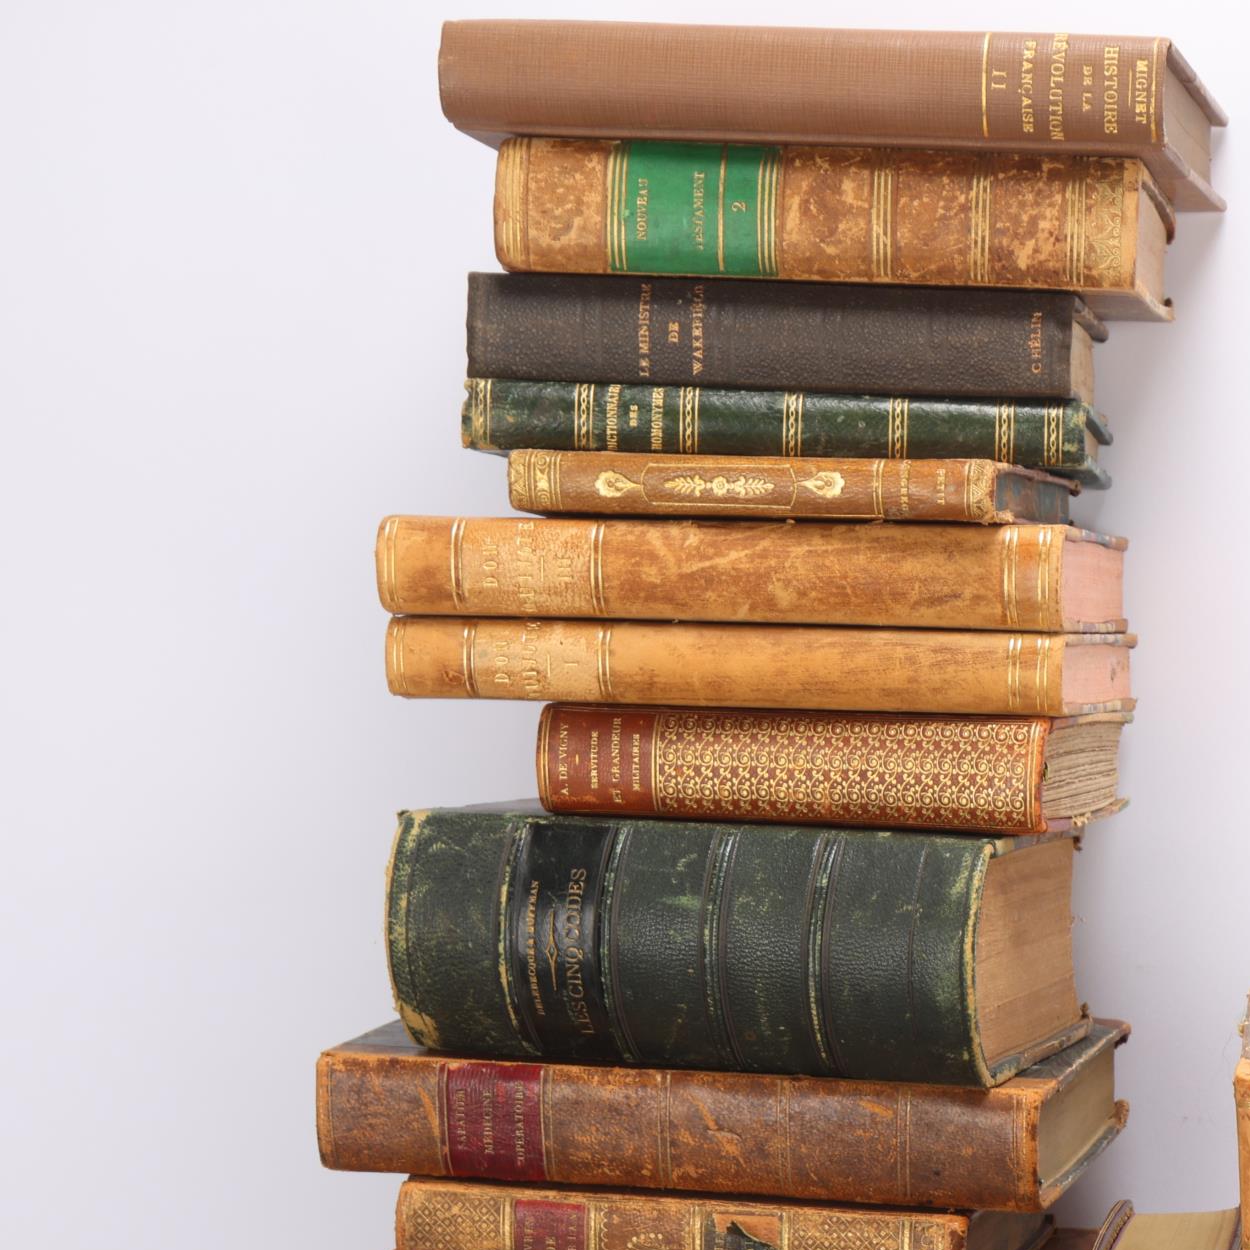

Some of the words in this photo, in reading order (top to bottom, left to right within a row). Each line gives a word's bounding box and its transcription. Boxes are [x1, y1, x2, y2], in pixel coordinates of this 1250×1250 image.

[991, 68, 1007, 90] II
[1017, 40, 1037, 133] FRANÇAISE
[1082, 66, 1093, 86] DE
[1104, 46, 1120, 134] HISTOIRE
[1135, 59, 1149, 124] MIGNET
[1082, 92, 1092, 112] LA
[637, 178, 649, 241] NOUVEAU
[693, 171, 706, 251] TESTAMENT
[731, 200, 746, 213] 2
[638, 283, 652, 353] MINISTRE
[668, 321, 680, 343] DE
[639, 357, 651, 377] LE
[629, 404, 638, 428] DES
[651, 387, 664, 450] HOMONYMES
[936, 468, 946, 506] PETIT
[482, 537, 498, 589] DON
[559, 723, 569, 759] VIGNY
[591, 731, 599, 789] SERVITUDE
[612, 718, 622, 782] GRANDEUR
[559, 763, 568, 779] DE
[560, 783, 569, 795] A.
[612, 789, 622, 803] ET
[566, 868, 587, 942] CODES
[565, 947, 584, 1000] CINQ
[571, 1001, 596, 1035] LES
